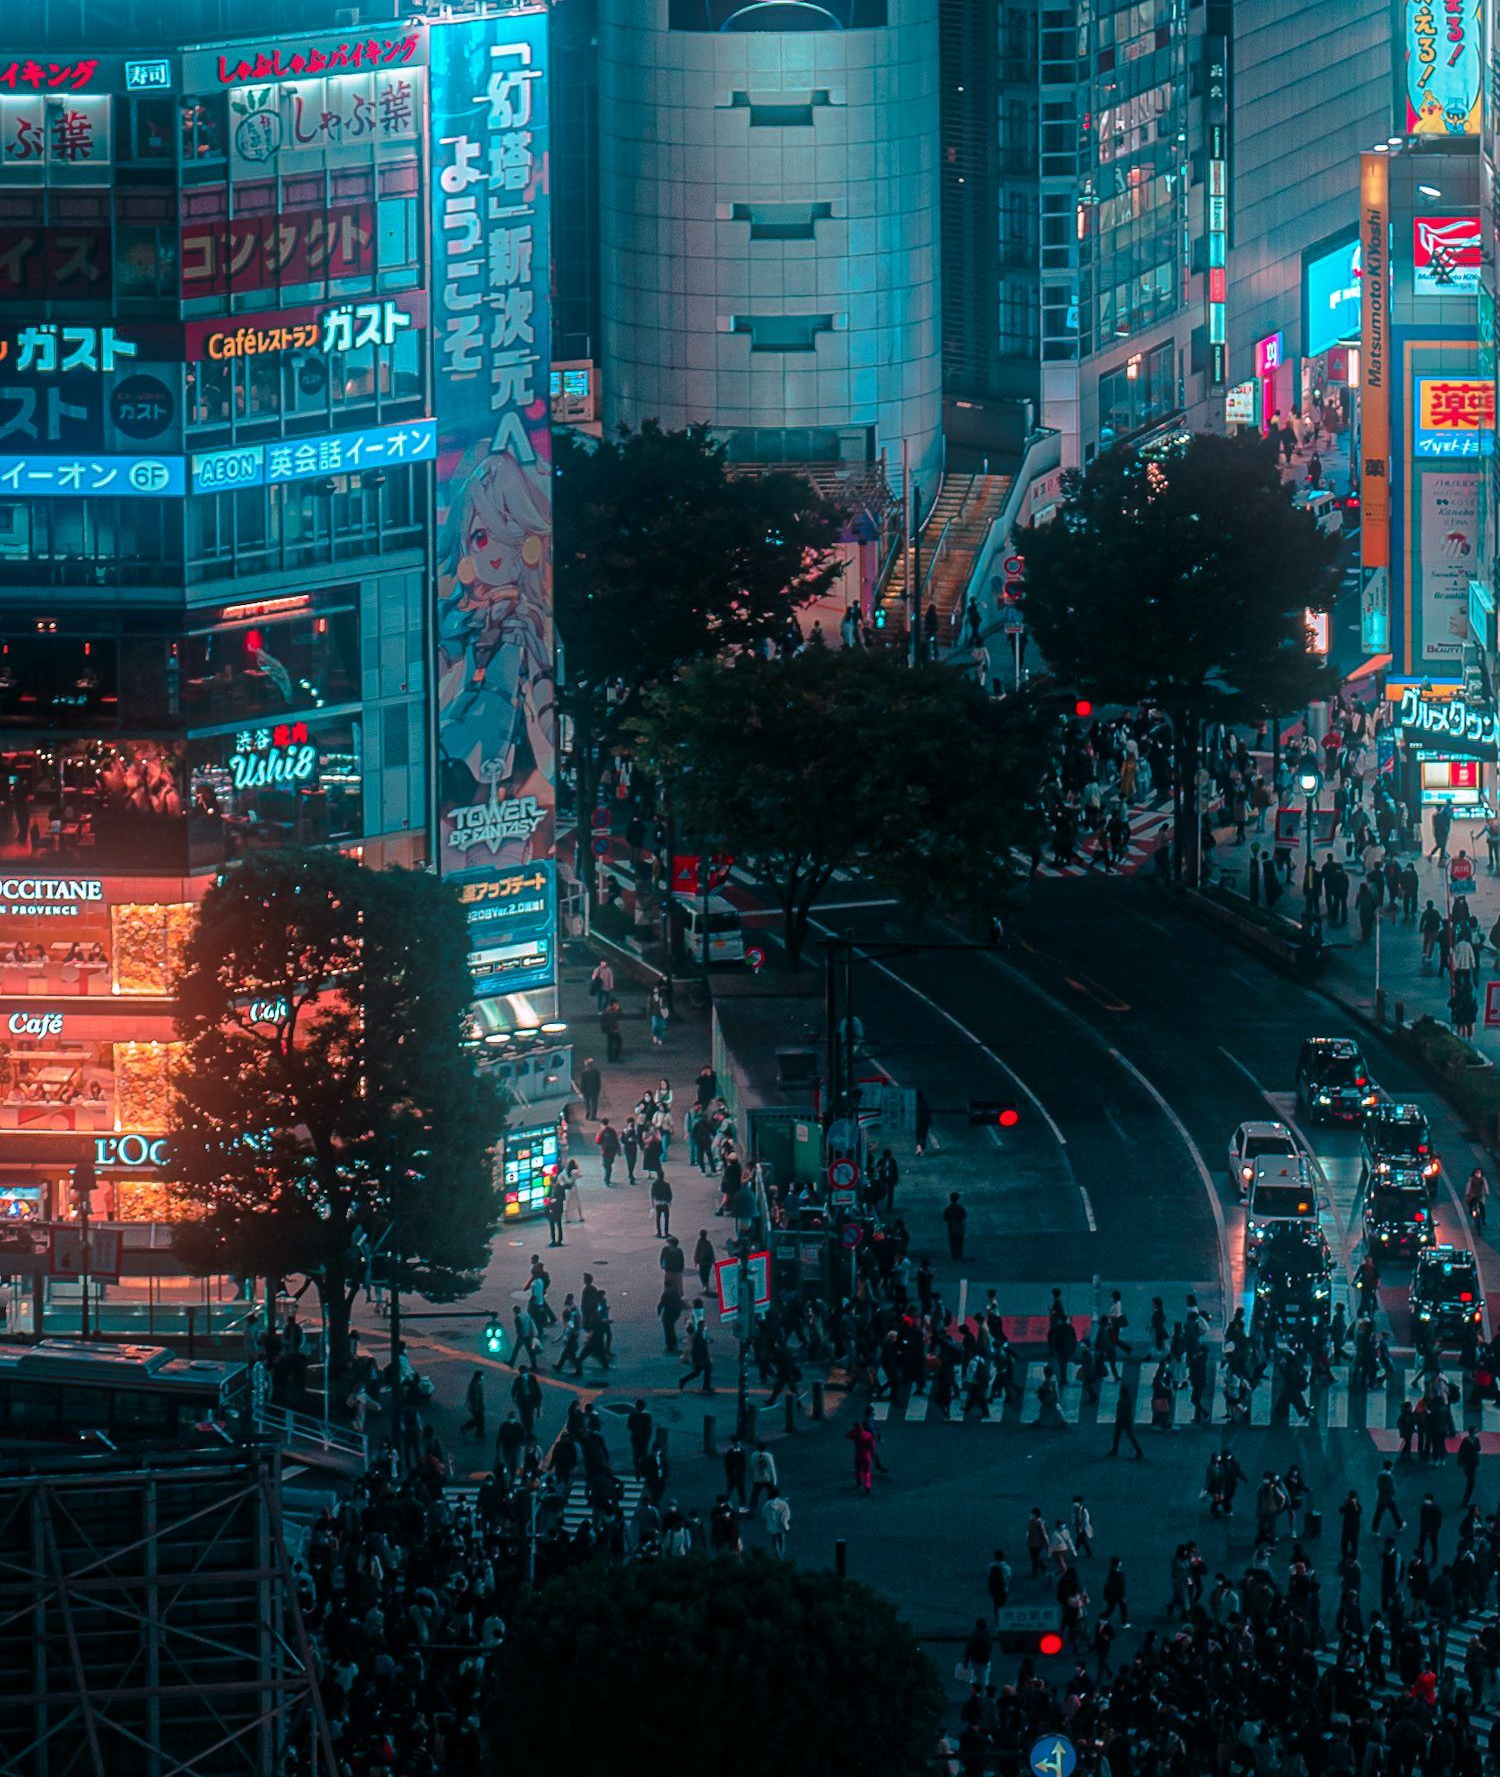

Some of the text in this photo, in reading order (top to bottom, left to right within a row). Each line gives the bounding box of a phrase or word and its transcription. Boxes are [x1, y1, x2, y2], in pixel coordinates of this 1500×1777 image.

[0, 60, 99, 89] イキング
[130, 64, 167, 85] 寿司
[218, 33, 420, 84] しゃぶしゃぶバイキング
[295, 80, 411, 143] しゃぶ葉
[183, 215, 370, 279] コンタクト
[439, 135, 489, 382] ようこそ
[473, 41, 543, 463] 「幻塔」新次元へ
[17, 324, 138, 372] ガスト
[209, 324, 319, 359] Caféレストラン
[323, 301, 411, 353] ガスト
[1367, 279, 1382, 388] Matsumoto
[1, 460, 164, 490] イーオン 6F
[202, 454, 256, 485] AEON
[270, 430, 431, 478] 英会話イーオン
[1401, 687, 1500, 744] グルメタウン
[230, 743, 316, 792] Ushi8
[447, 796, 548, 830] TOWER
[12, 905, 79, 916] PROVENCE
[8, 1012, 64, 1039] Café
